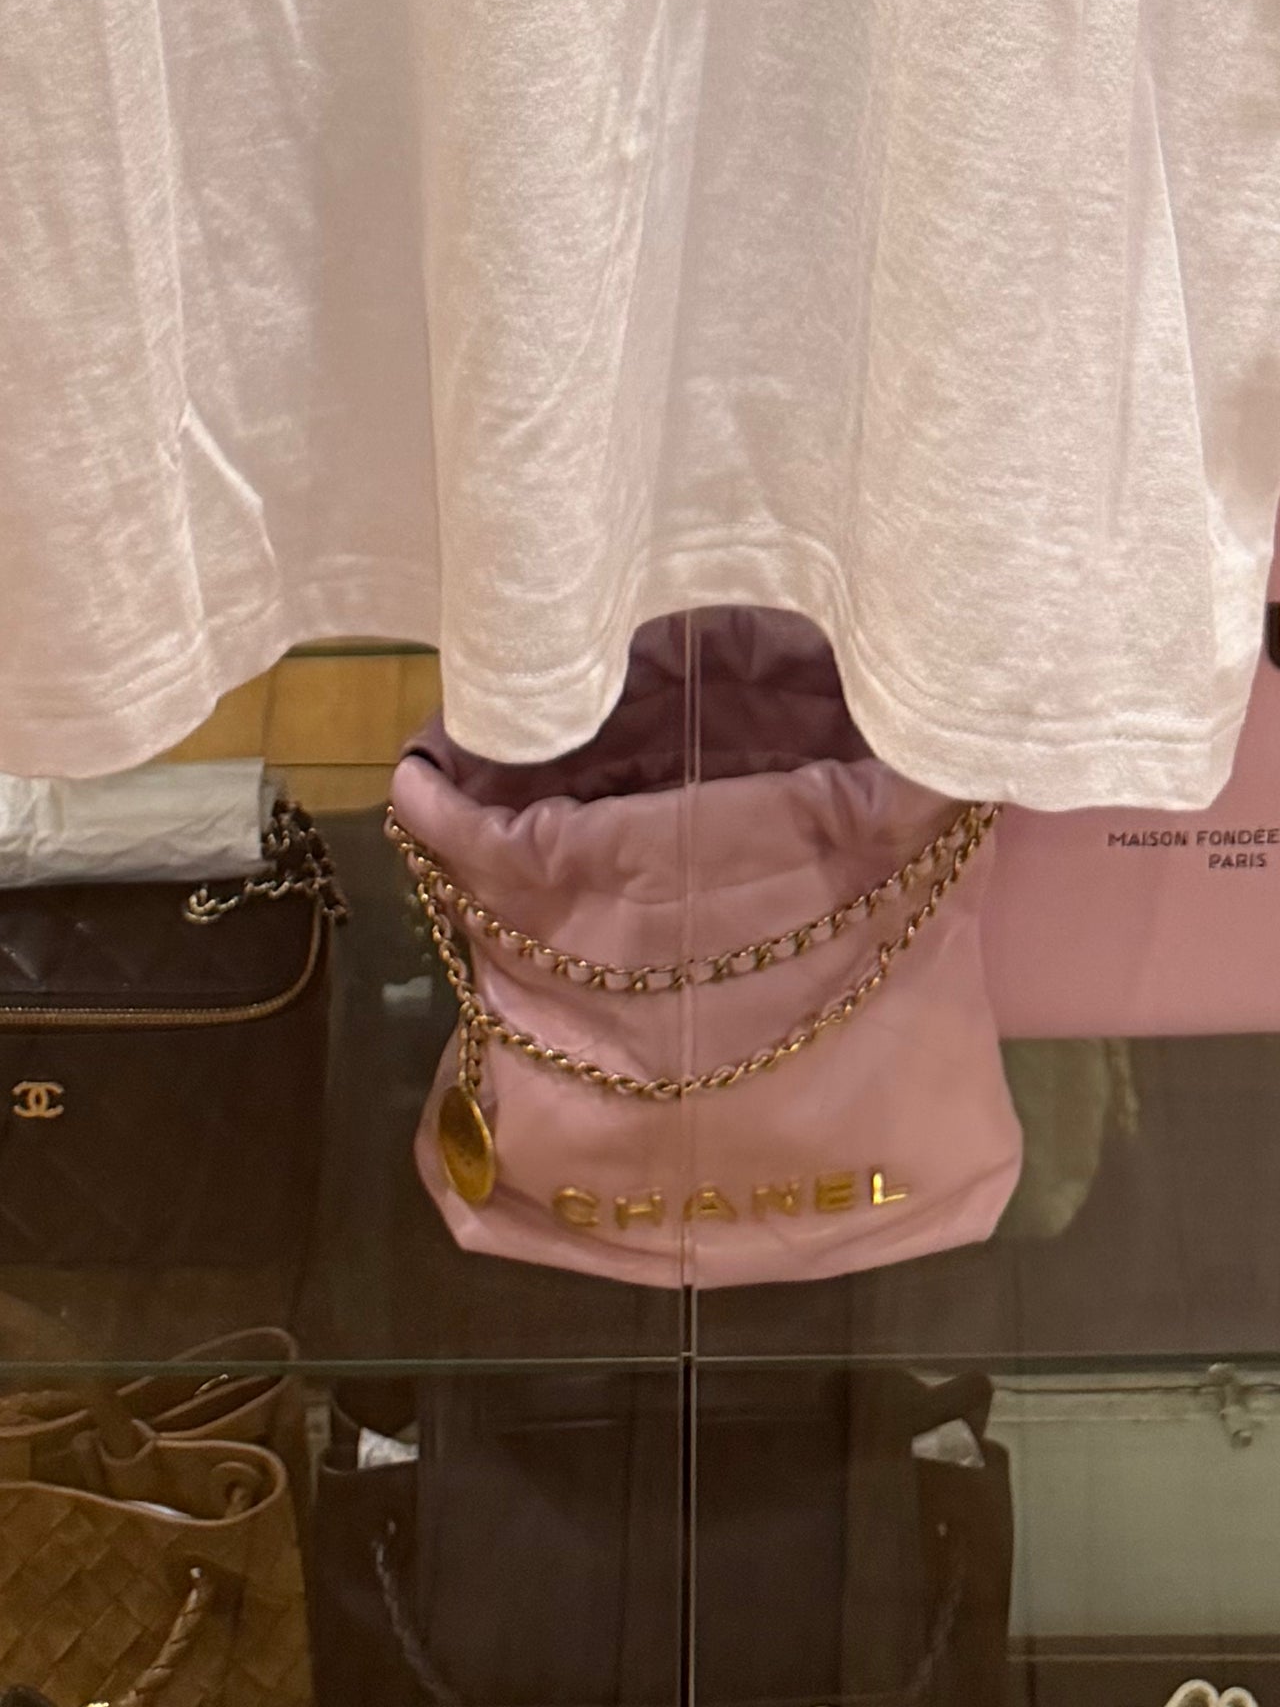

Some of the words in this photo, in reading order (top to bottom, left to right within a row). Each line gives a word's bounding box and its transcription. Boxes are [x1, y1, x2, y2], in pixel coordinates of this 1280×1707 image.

[1107, 830, 1189, 848] MAISON
[1208, 852, 1268, 869] PARIS
[551, 1171, 910, 1231] CHANEL
